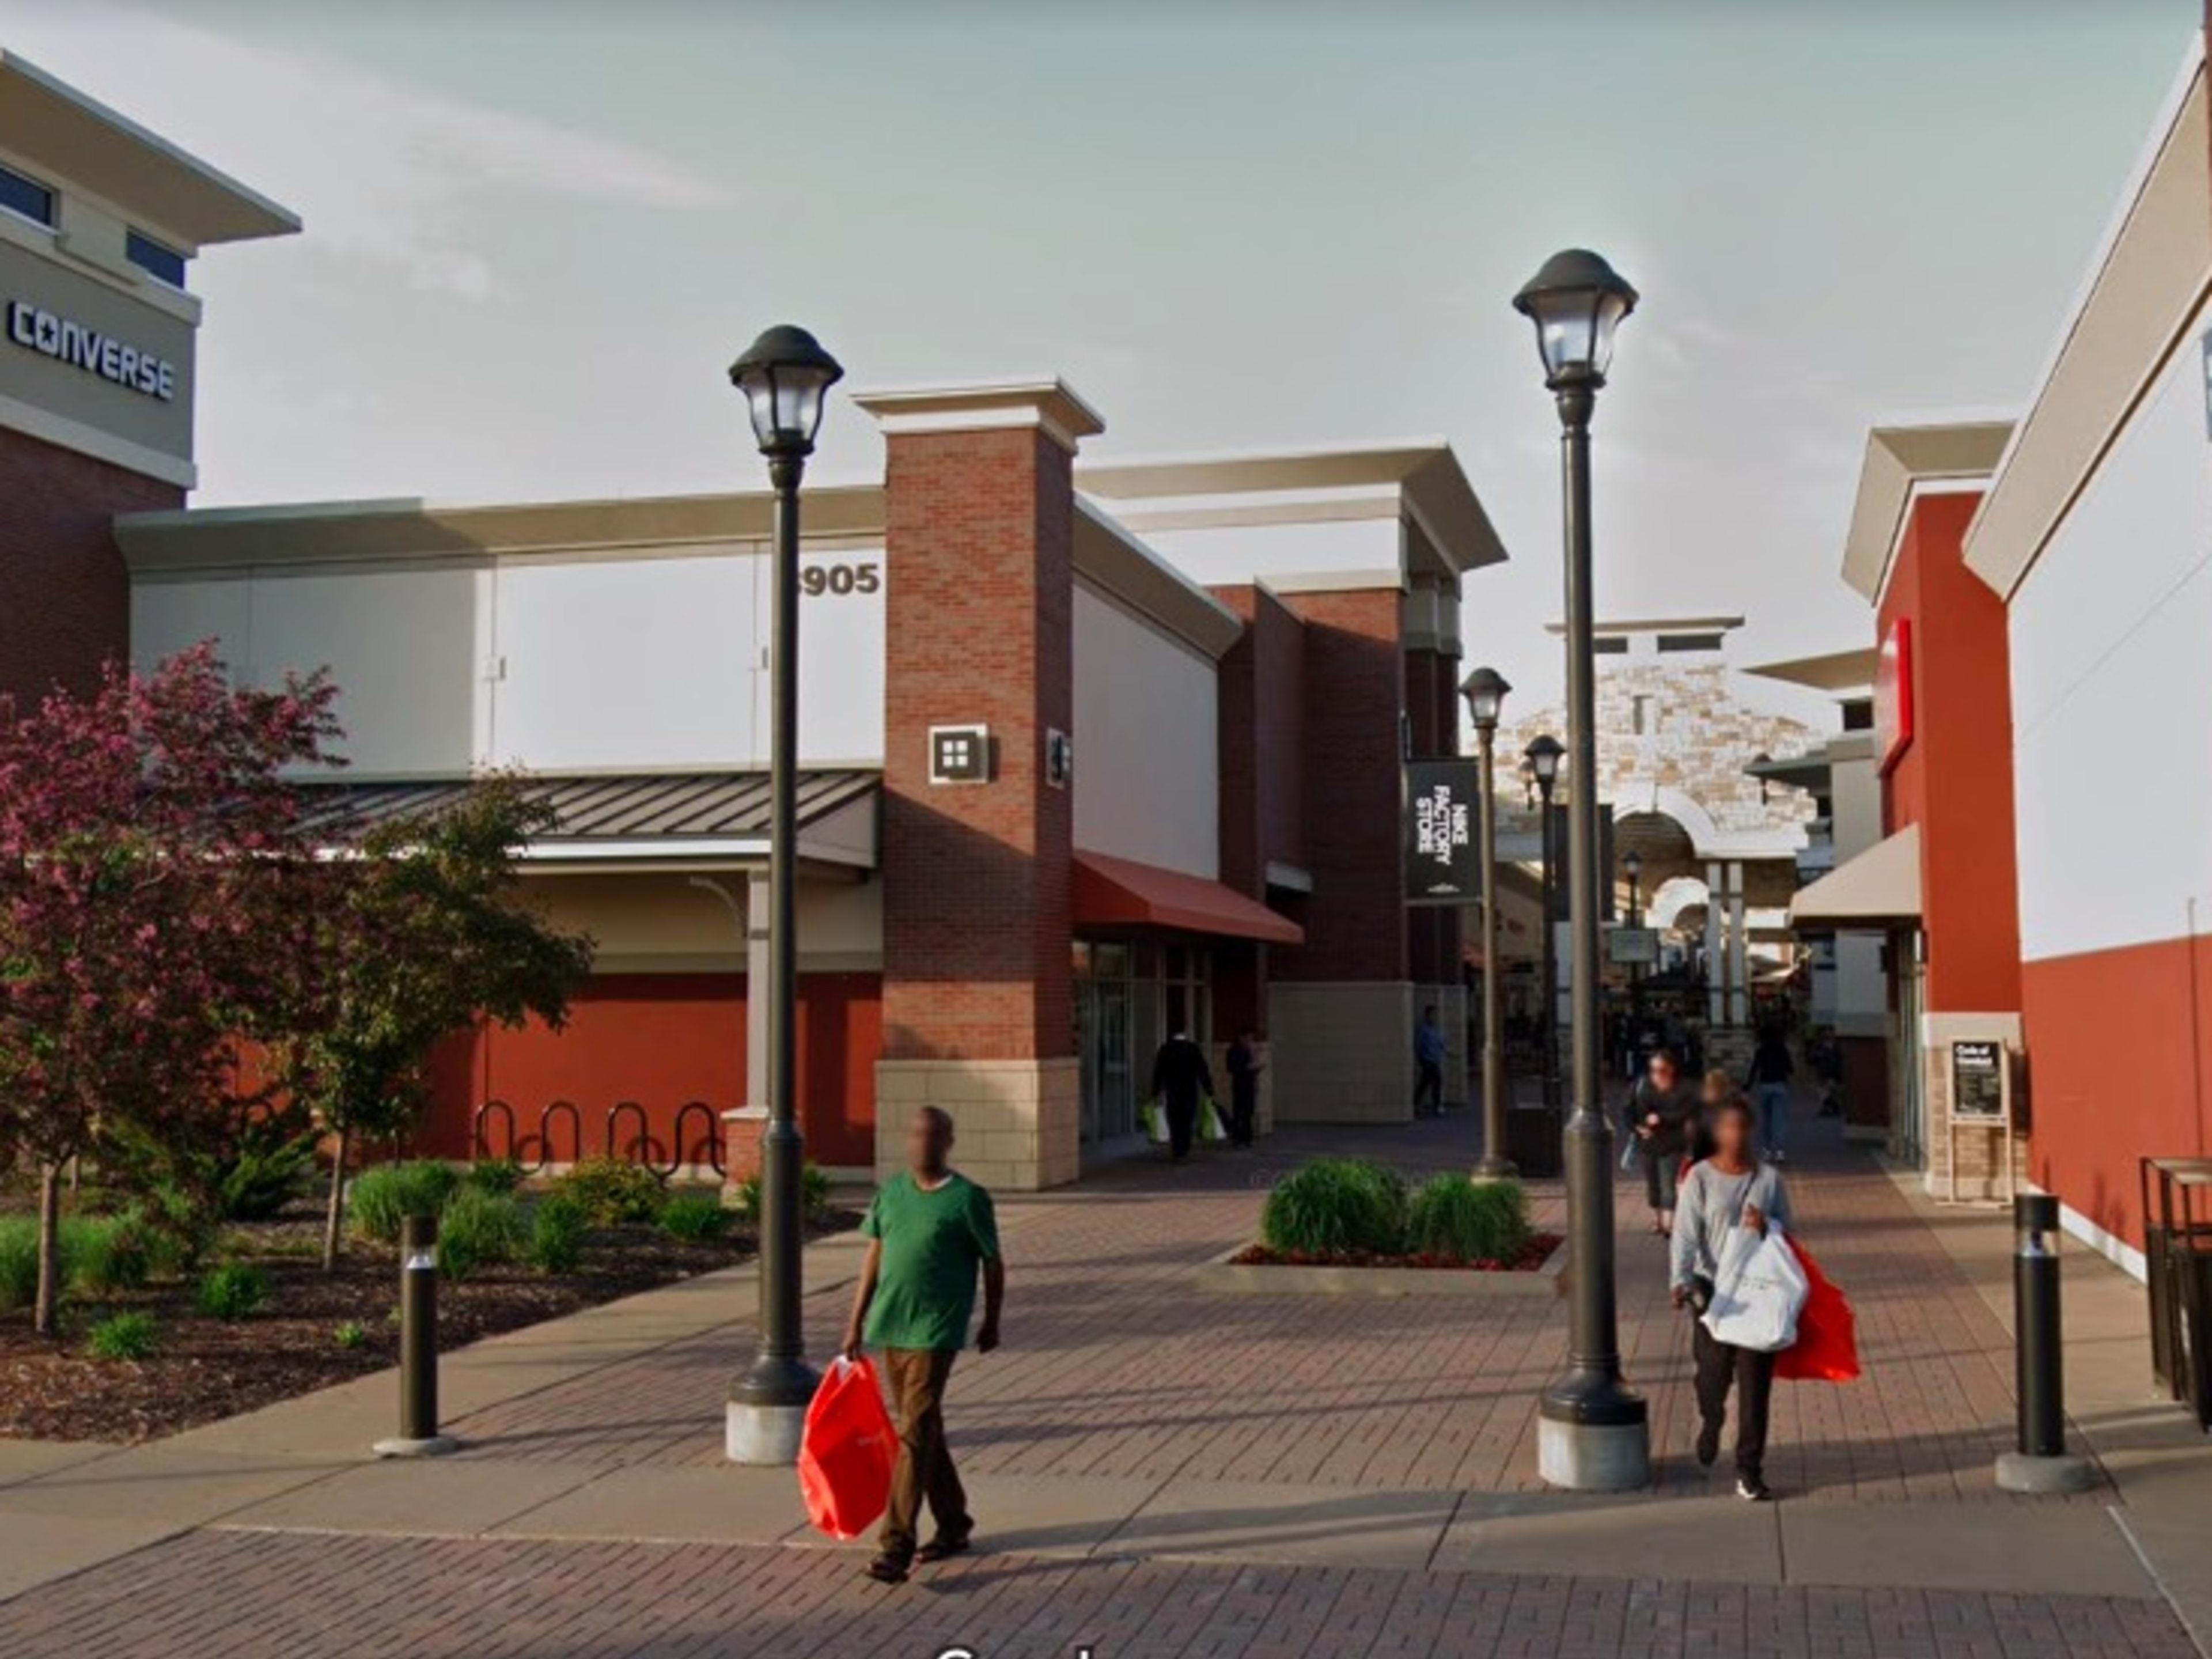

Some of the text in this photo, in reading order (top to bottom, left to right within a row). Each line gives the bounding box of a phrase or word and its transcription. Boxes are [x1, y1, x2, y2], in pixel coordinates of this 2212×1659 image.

[10, 301, 173, 400] CONVERSE
[798, 563, 880, 597] 905
[1416, 797, 1433, 853] STORE
[1433, 785, 1451, 865] FACTORY
[1452, 804, 1468, 844] NIKE
